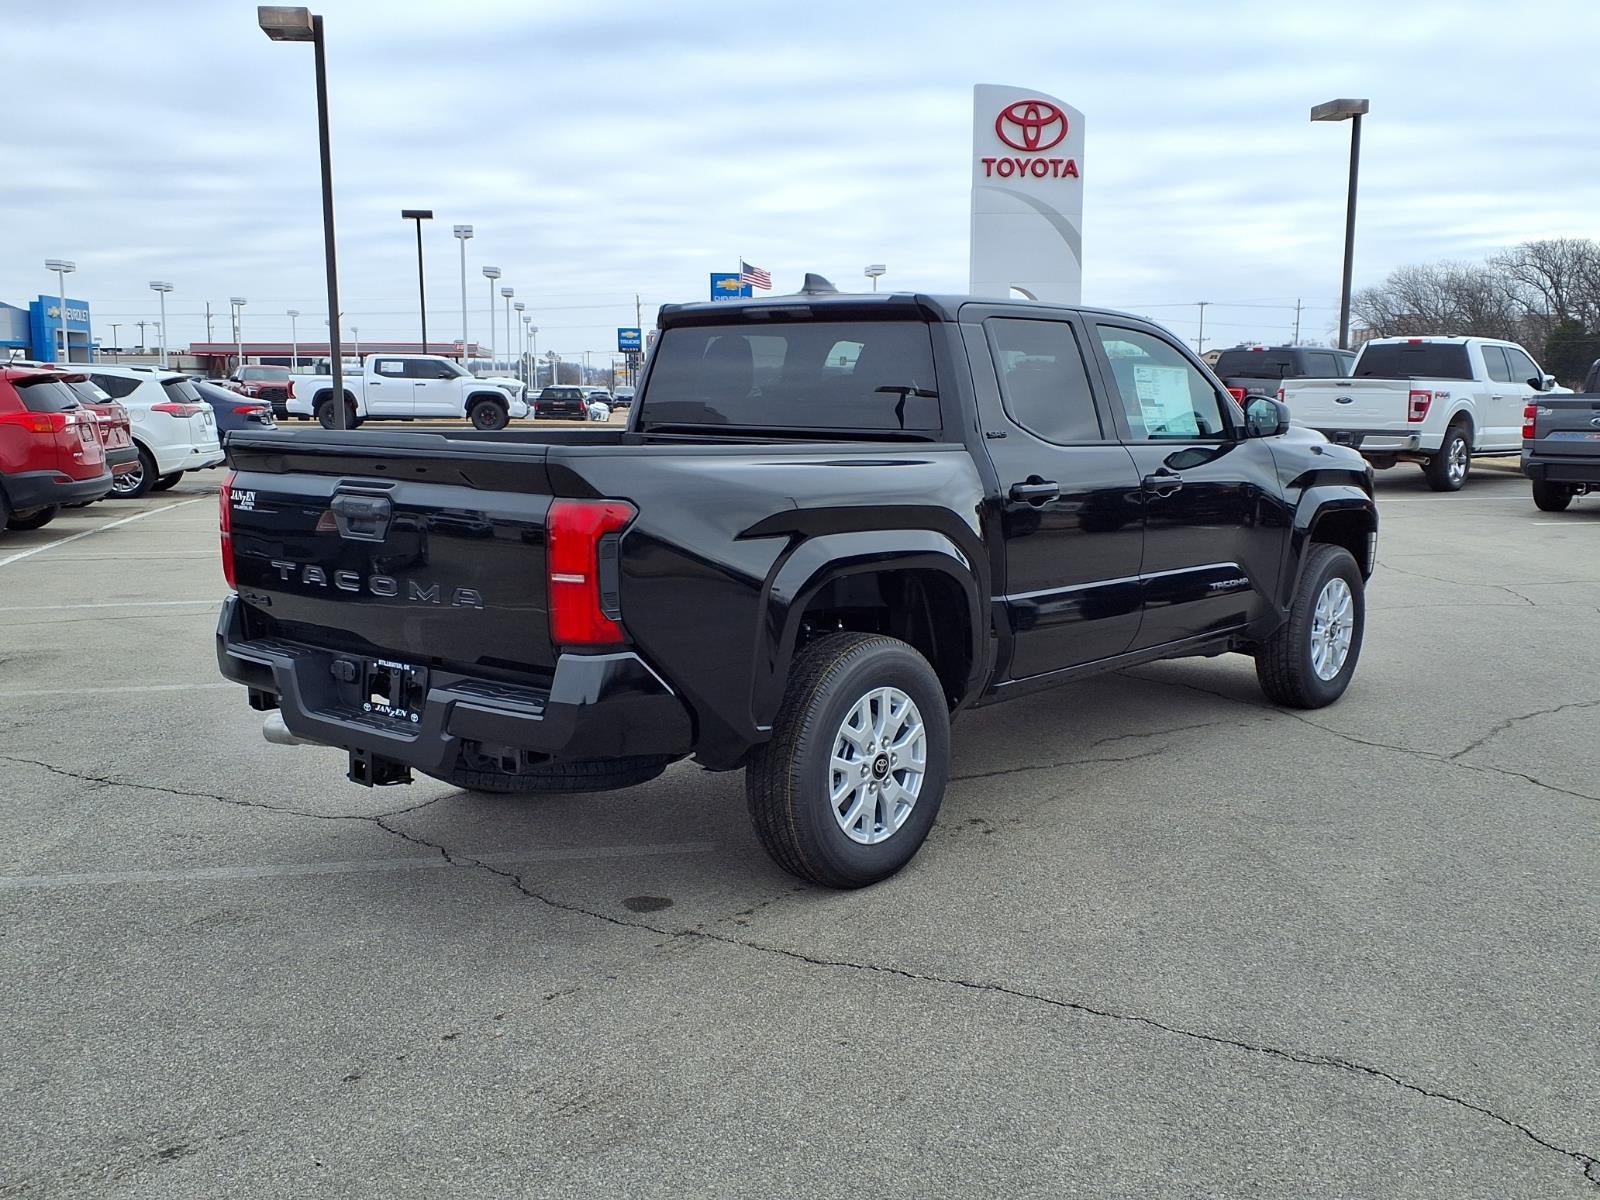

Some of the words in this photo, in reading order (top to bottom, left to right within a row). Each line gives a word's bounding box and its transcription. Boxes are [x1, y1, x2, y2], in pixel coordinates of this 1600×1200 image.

[982, 158, 1079, 179] TOYOTA
[271, 559, 485, 610] TACOMA
[374, 704, 408, 718] JANZEN
